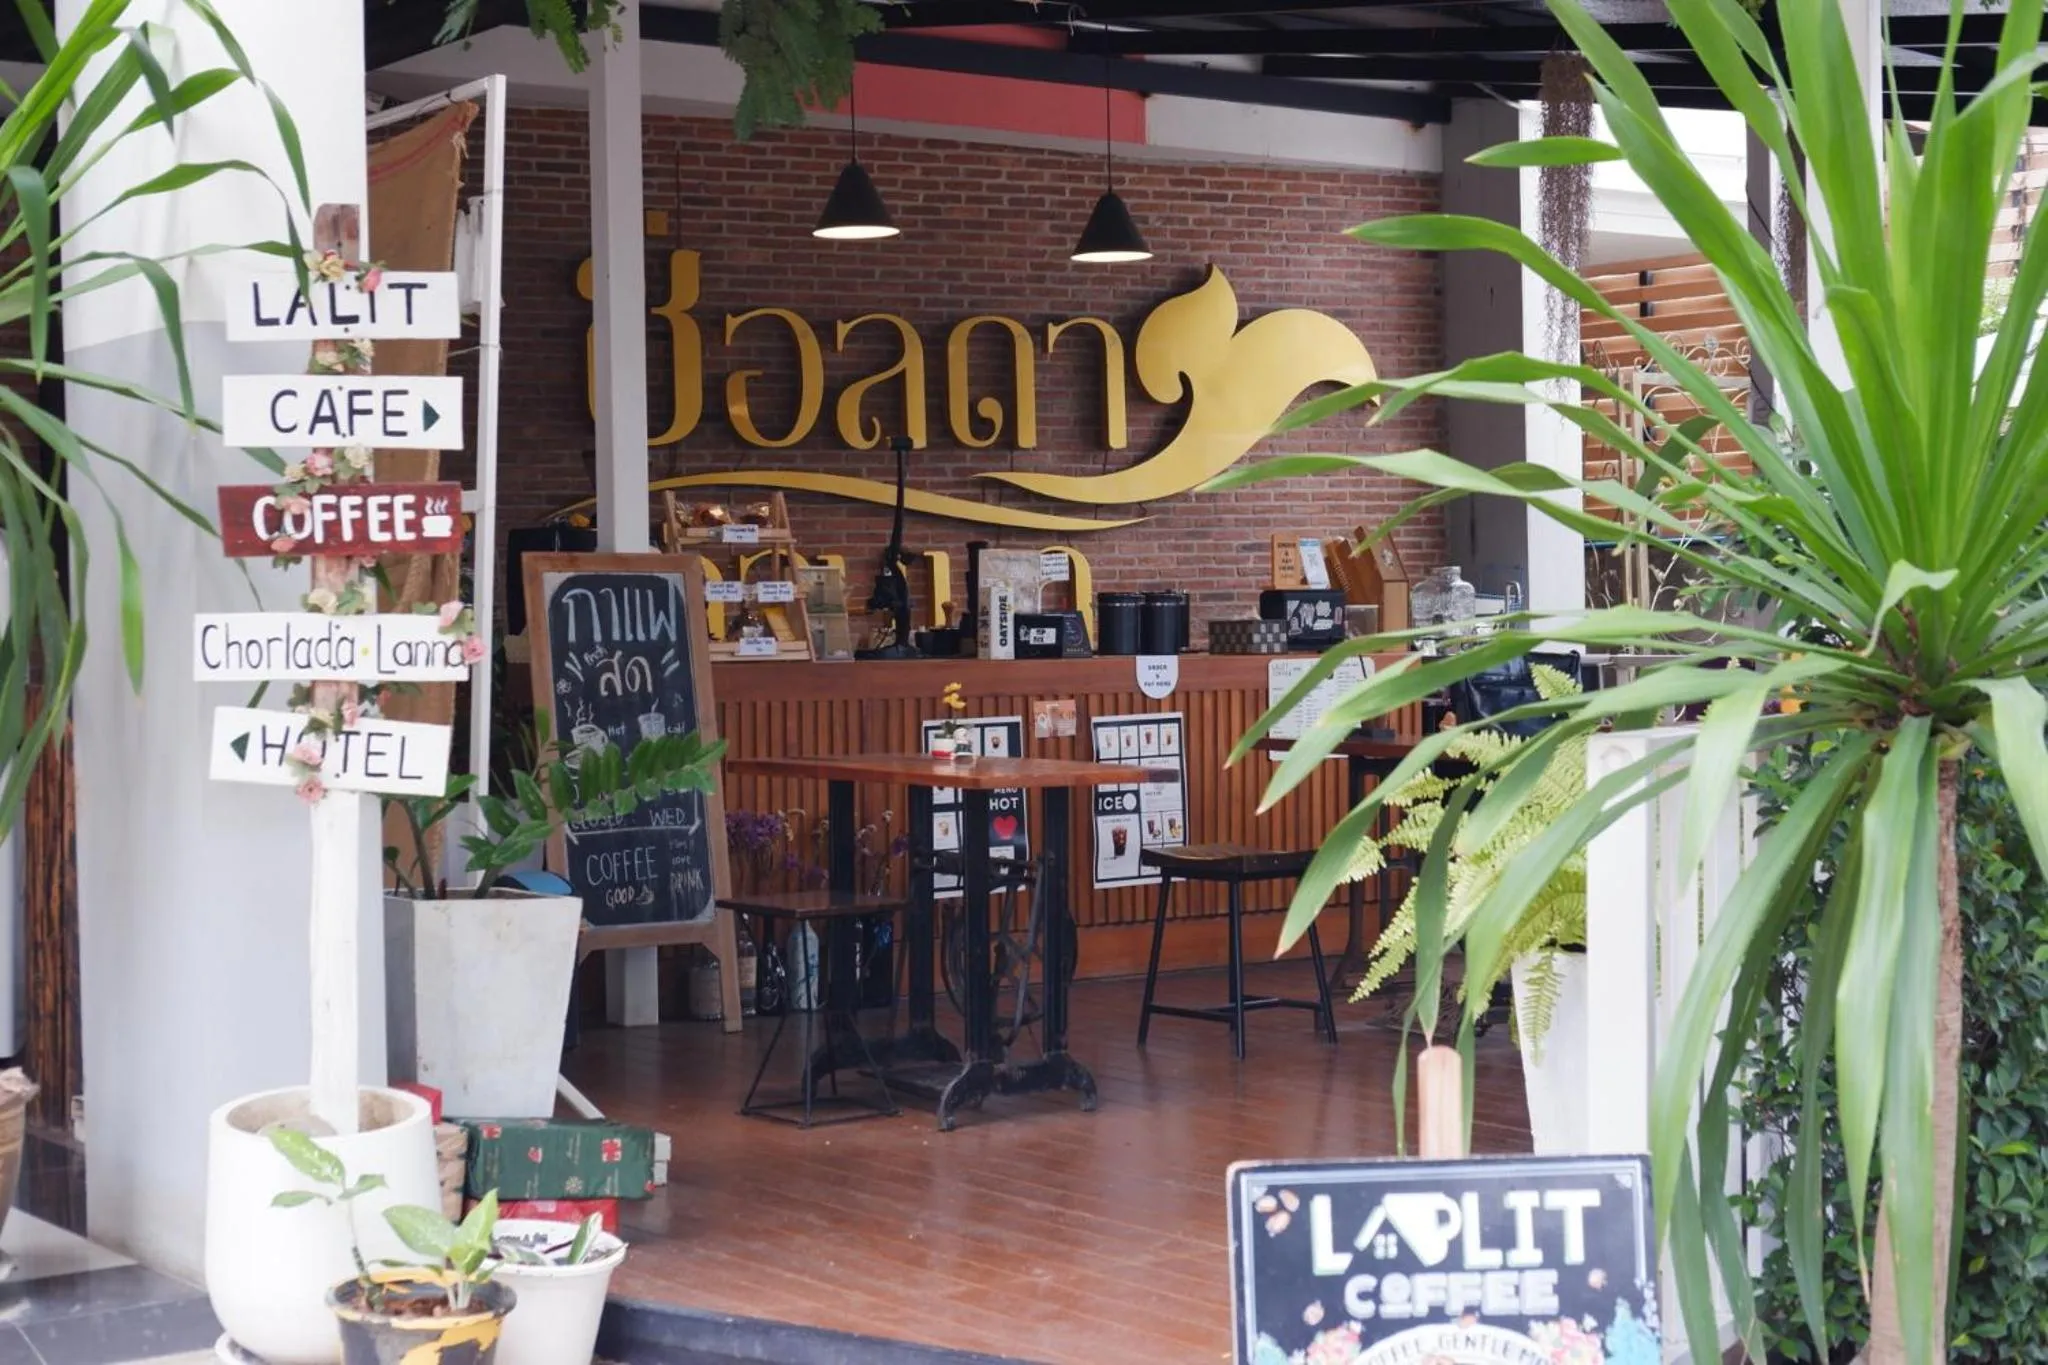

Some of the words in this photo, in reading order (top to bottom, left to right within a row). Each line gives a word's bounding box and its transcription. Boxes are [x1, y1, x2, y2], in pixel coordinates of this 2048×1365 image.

[253, 282, 428, 327] LALIT
[270, 389, 409, 437] CAFE
[253, 494, 417, 544] COFFEE
[561, 587, 677, 643] กาแฟ
[999, 595, 1008, 647] OATSIDE
[201, 622, 356, 670] Chorlada
[377, 624, 466, 674] Lanna
[596, 649, 653, 697] สด
[989, 797, 1019, 810] HOT
[1098, 796, 1123, 811] ICE
[586, 846, 659, 886] COFFEE
[605, 886, 636, 909] GOOD
[1344, 1269, 1560, 1320] COFFEE
